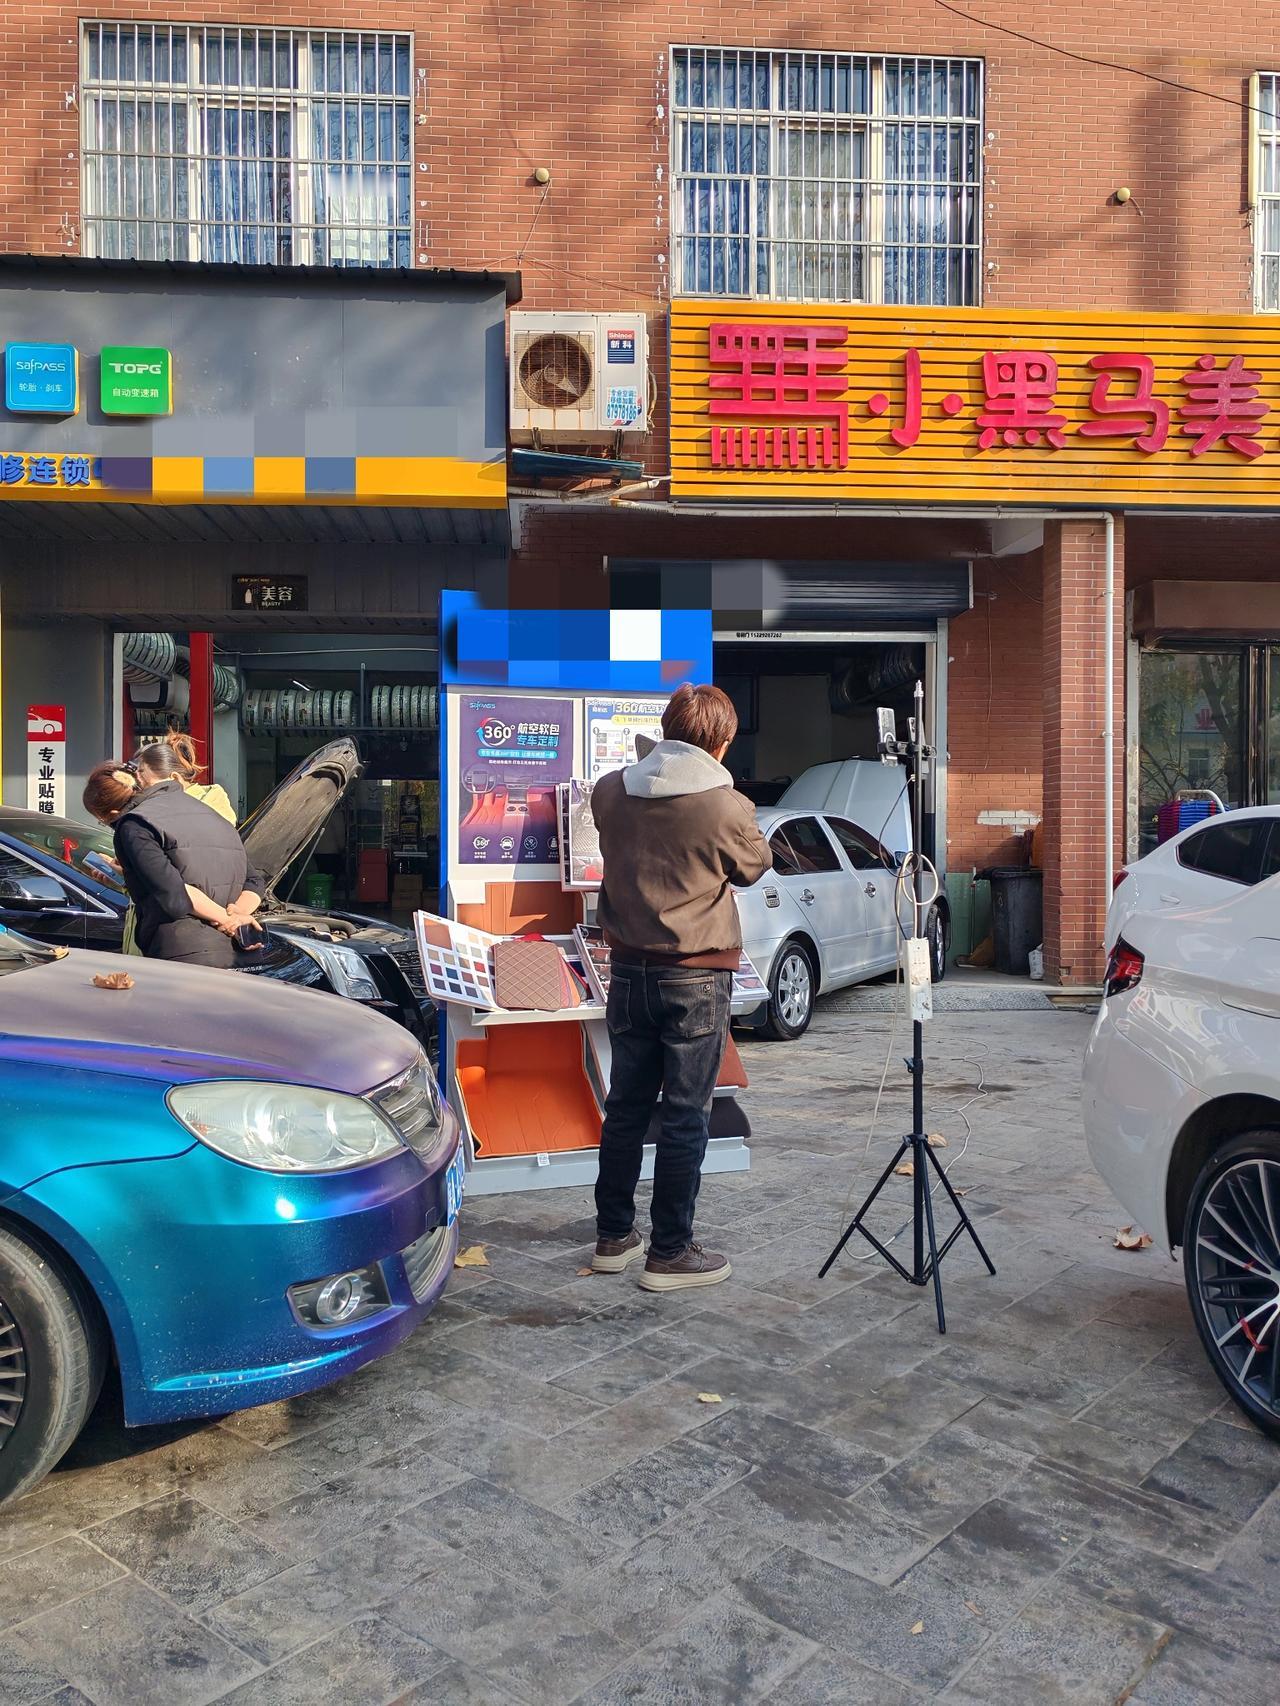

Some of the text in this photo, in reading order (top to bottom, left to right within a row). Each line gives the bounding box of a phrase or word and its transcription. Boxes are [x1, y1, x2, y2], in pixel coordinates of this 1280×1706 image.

[109, 363, 161, 375] TOPG
[112, 388, 160, 398] 自动变速箱
[261, 586, 293, 601] 美容
[517, 723, 560, 736] 航空软包
[516, 735, 559, 747] 专车定制
[38, 747, 55, 814] 专业贴膜
